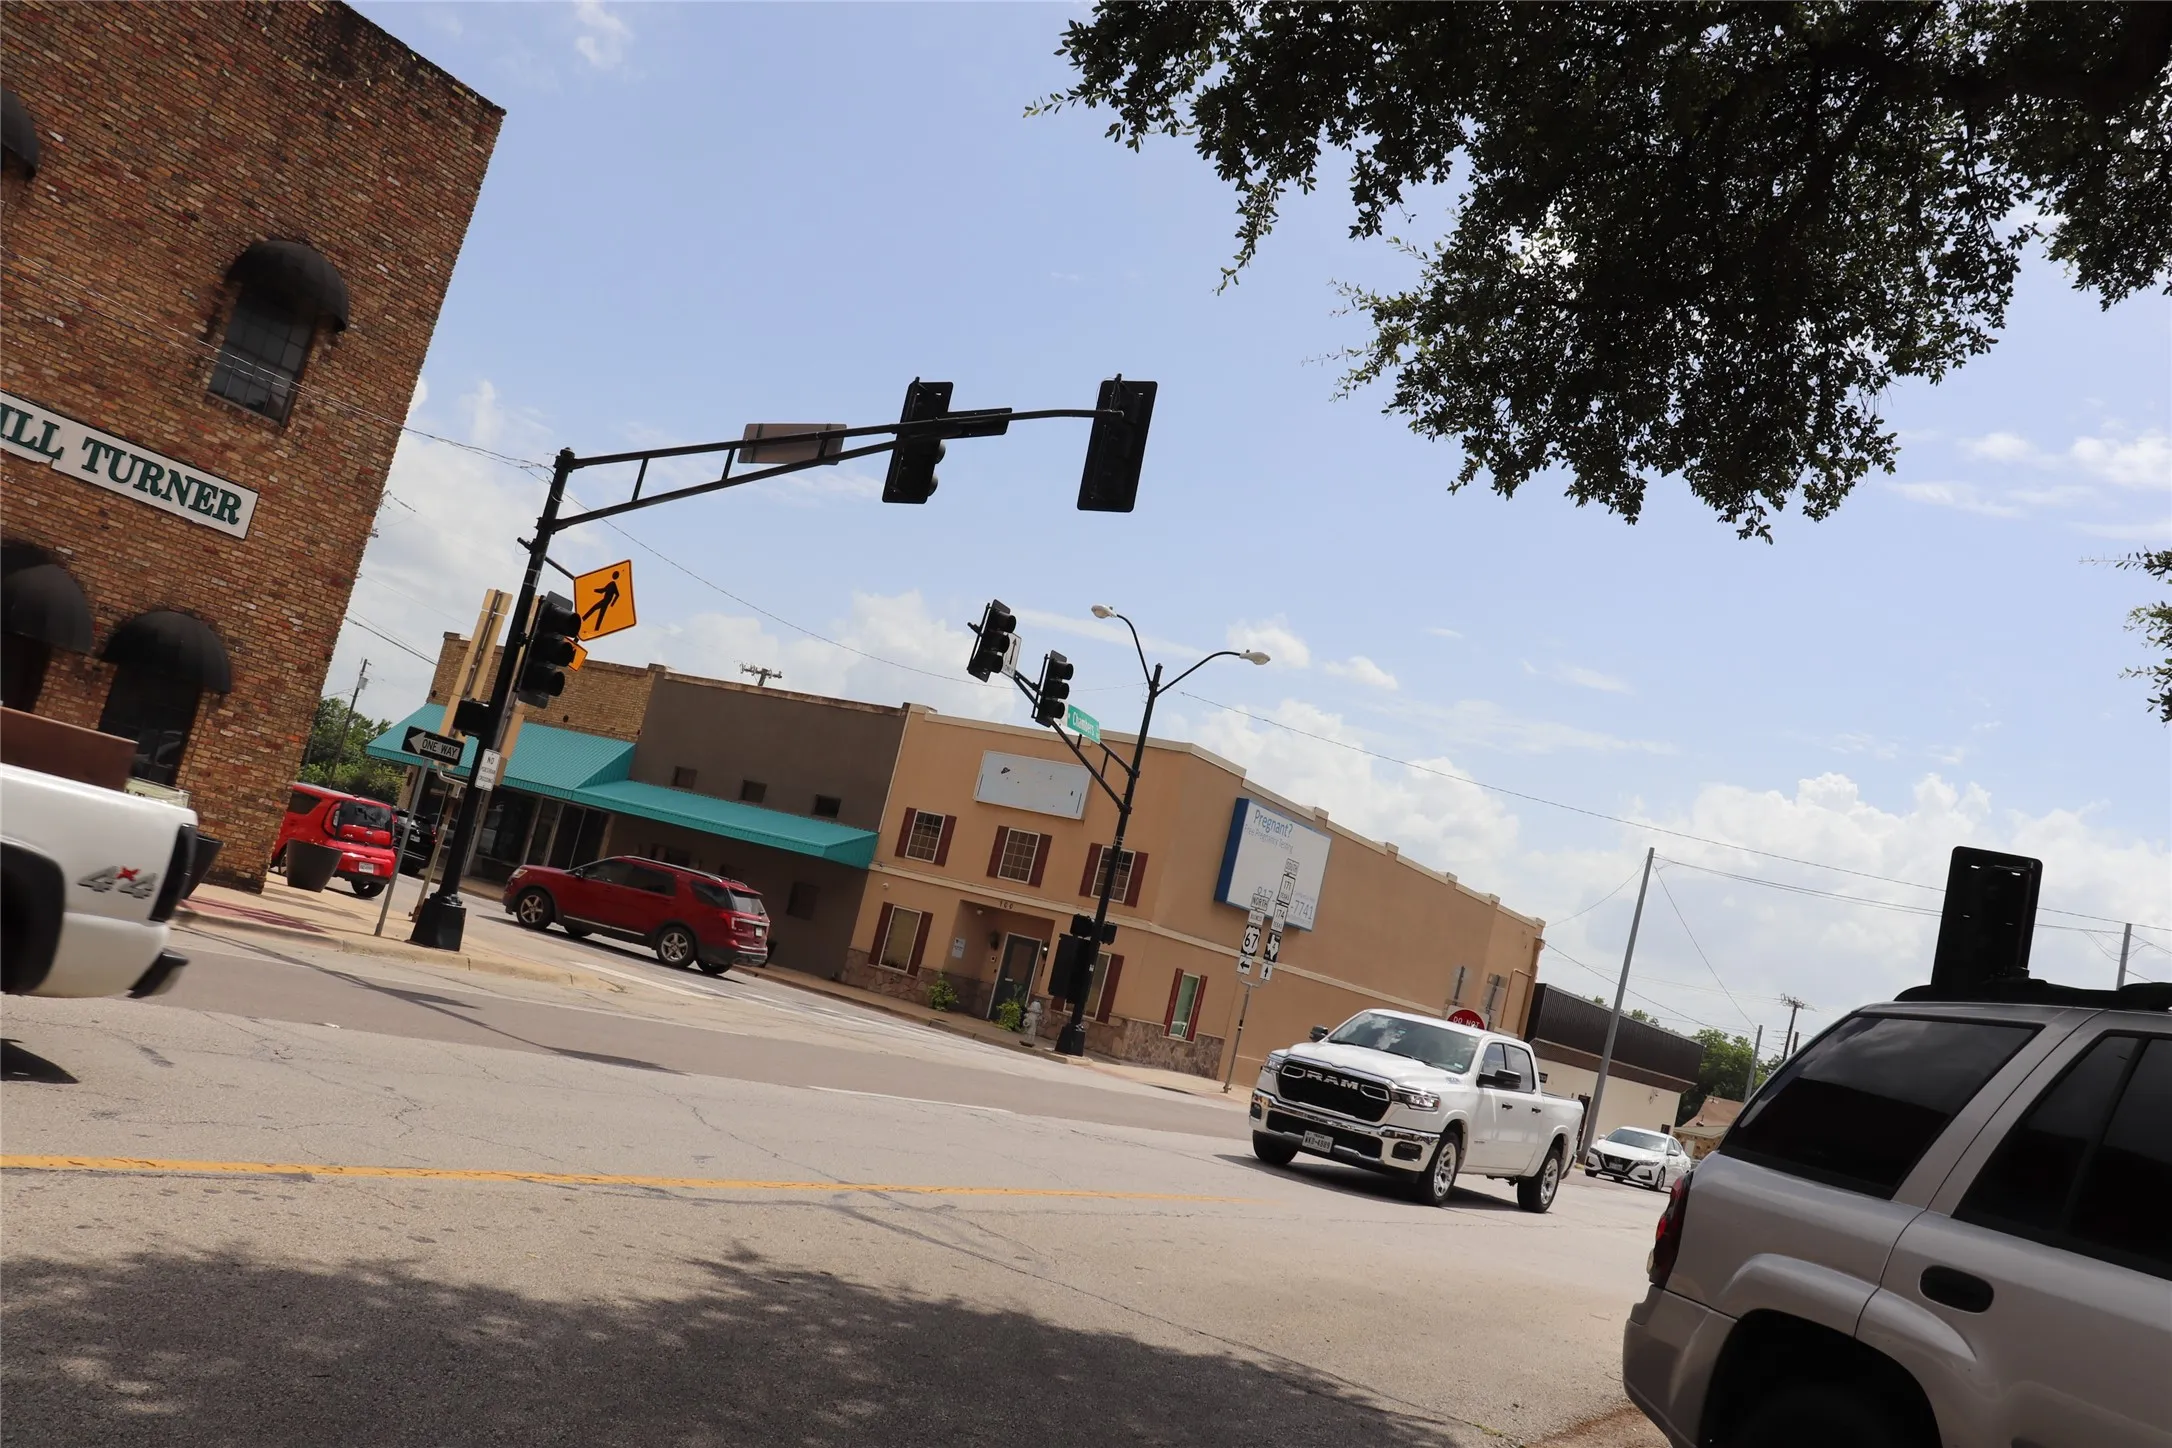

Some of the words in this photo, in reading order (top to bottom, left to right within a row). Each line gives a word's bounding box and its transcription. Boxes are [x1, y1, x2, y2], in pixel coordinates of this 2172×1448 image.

[81, 436, 242, 525] TURNER
[421, 738, 438, 752] ONE
[440, 744, 458, 757] WAY
[486, 757, 495, 765] NO
[1253, 809, 1294, 838] Pregnant?
[1252, 896, 1268, 907] NORTH
[1245, 932, 1259, 949] 67
[1453, 1016, 1463, 1024] DO
[1465, 1019, 1480, 1029] NOT
[1306, 1069, 1359, 1091] RAM
